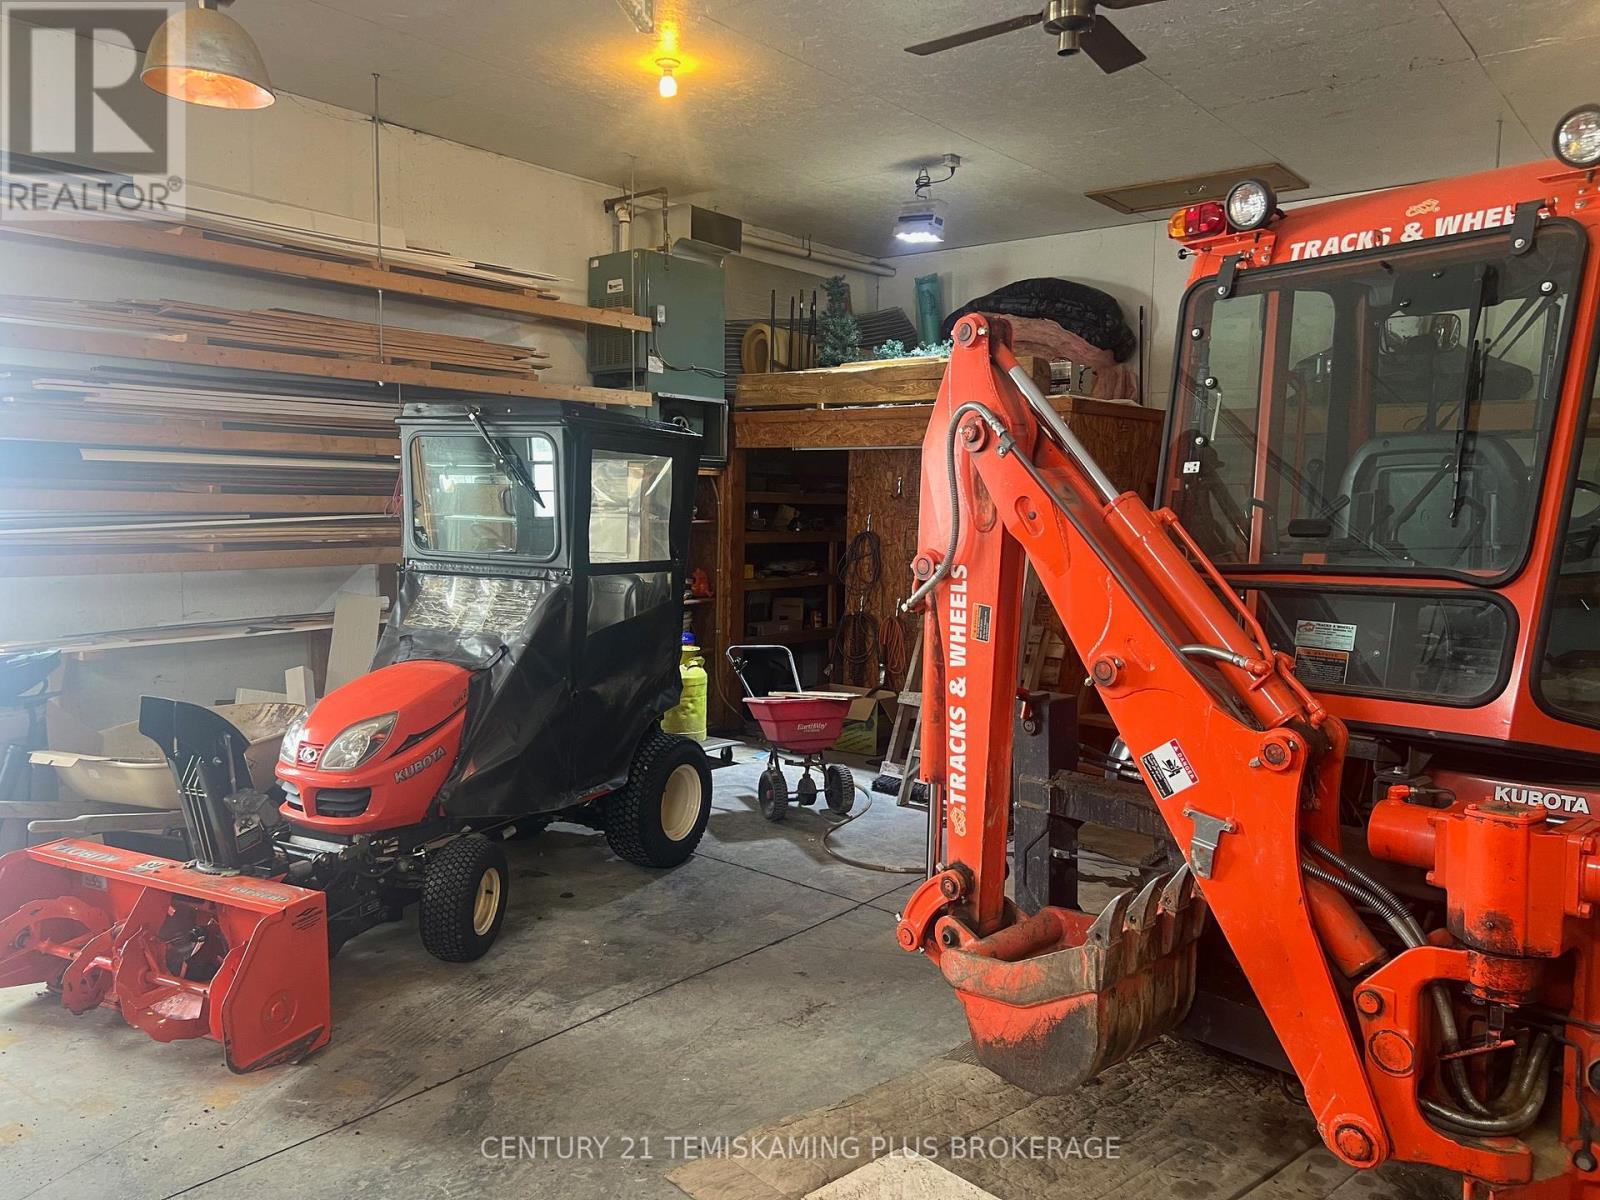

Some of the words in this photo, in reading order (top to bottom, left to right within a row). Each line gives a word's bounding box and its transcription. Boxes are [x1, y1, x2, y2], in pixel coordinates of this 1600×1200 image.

[1289, 226, 1393, 262] TRACKS
[1400, 222, 1424, 243] &
[949, 564, 968, 668] WHEELS
[948, 676, 967, 699] &
[394, 745, 448, 785] KUBOTA
[949, 705, 967, 805] TRACKS
[1177, 752, 1196, 780] DANGER
[1494, 785, 1590, 815] KUBOTA
